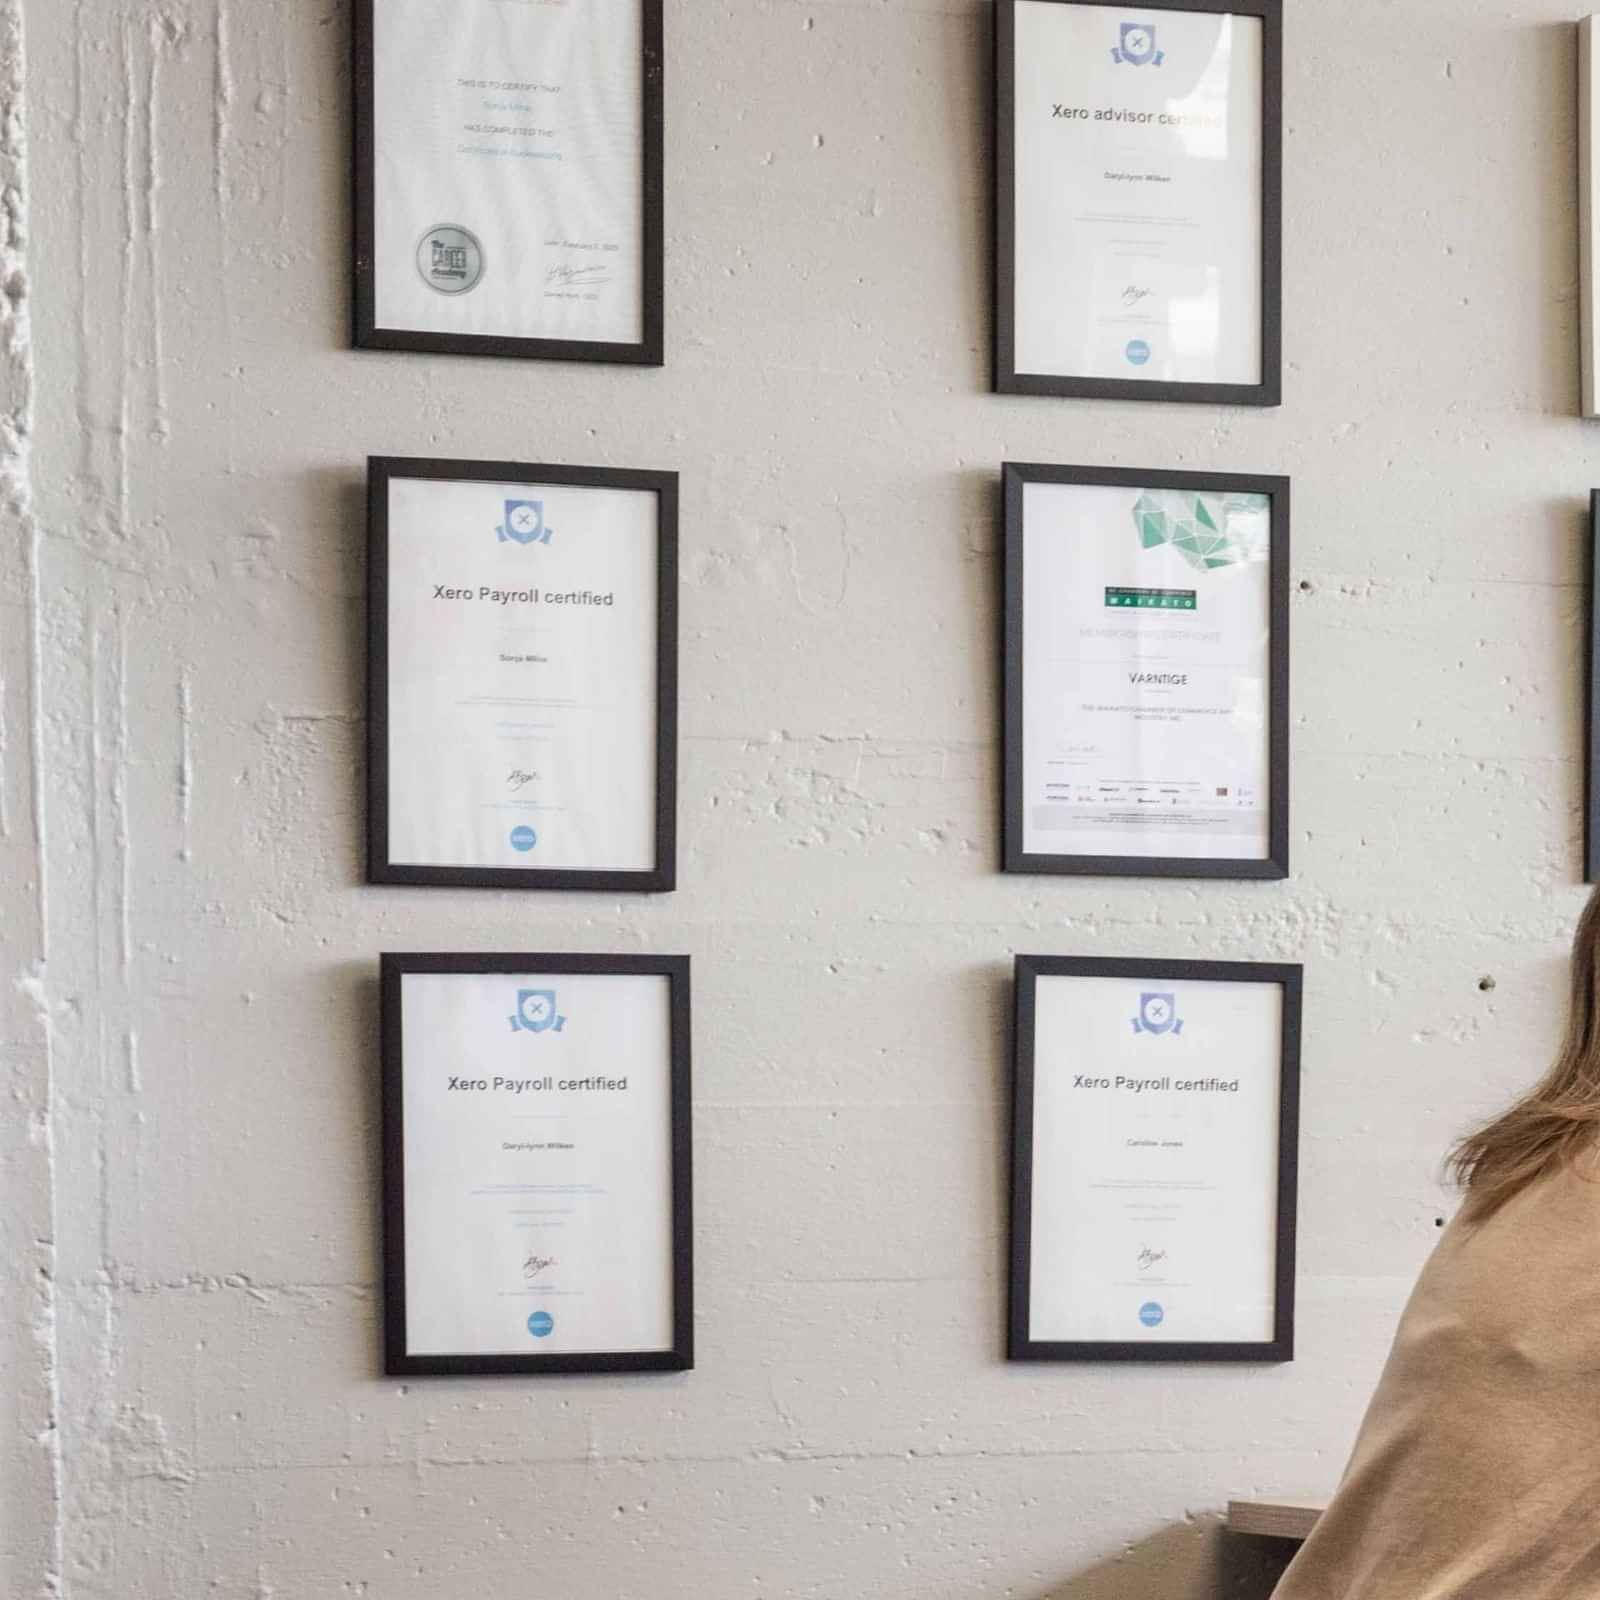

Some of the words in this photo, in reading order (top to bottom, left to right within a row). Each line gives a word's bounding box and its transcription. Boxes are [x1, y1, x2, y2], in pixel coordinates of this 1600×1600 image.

[1051, 103, 1089, 120] Xero
[1094, 107, 1154, 124] advisor
[433, 584, 475, 601] Xero
[479, 586, 539, 606] Payroll
[543, 591, 614, 607] certified
[1128, 672, 1189, 687] VARNTIGE
[447, 1076, 488, 1091] Xero
[493, 1076, 553, 1095] Payroll
[557, 1076, 628, 1091] certified
[1073, 1074, 1109, 1089] Xero
[1114, 1076, 1170, 1094] Payroll
[1174, 1078, 1239, 1093] certified
